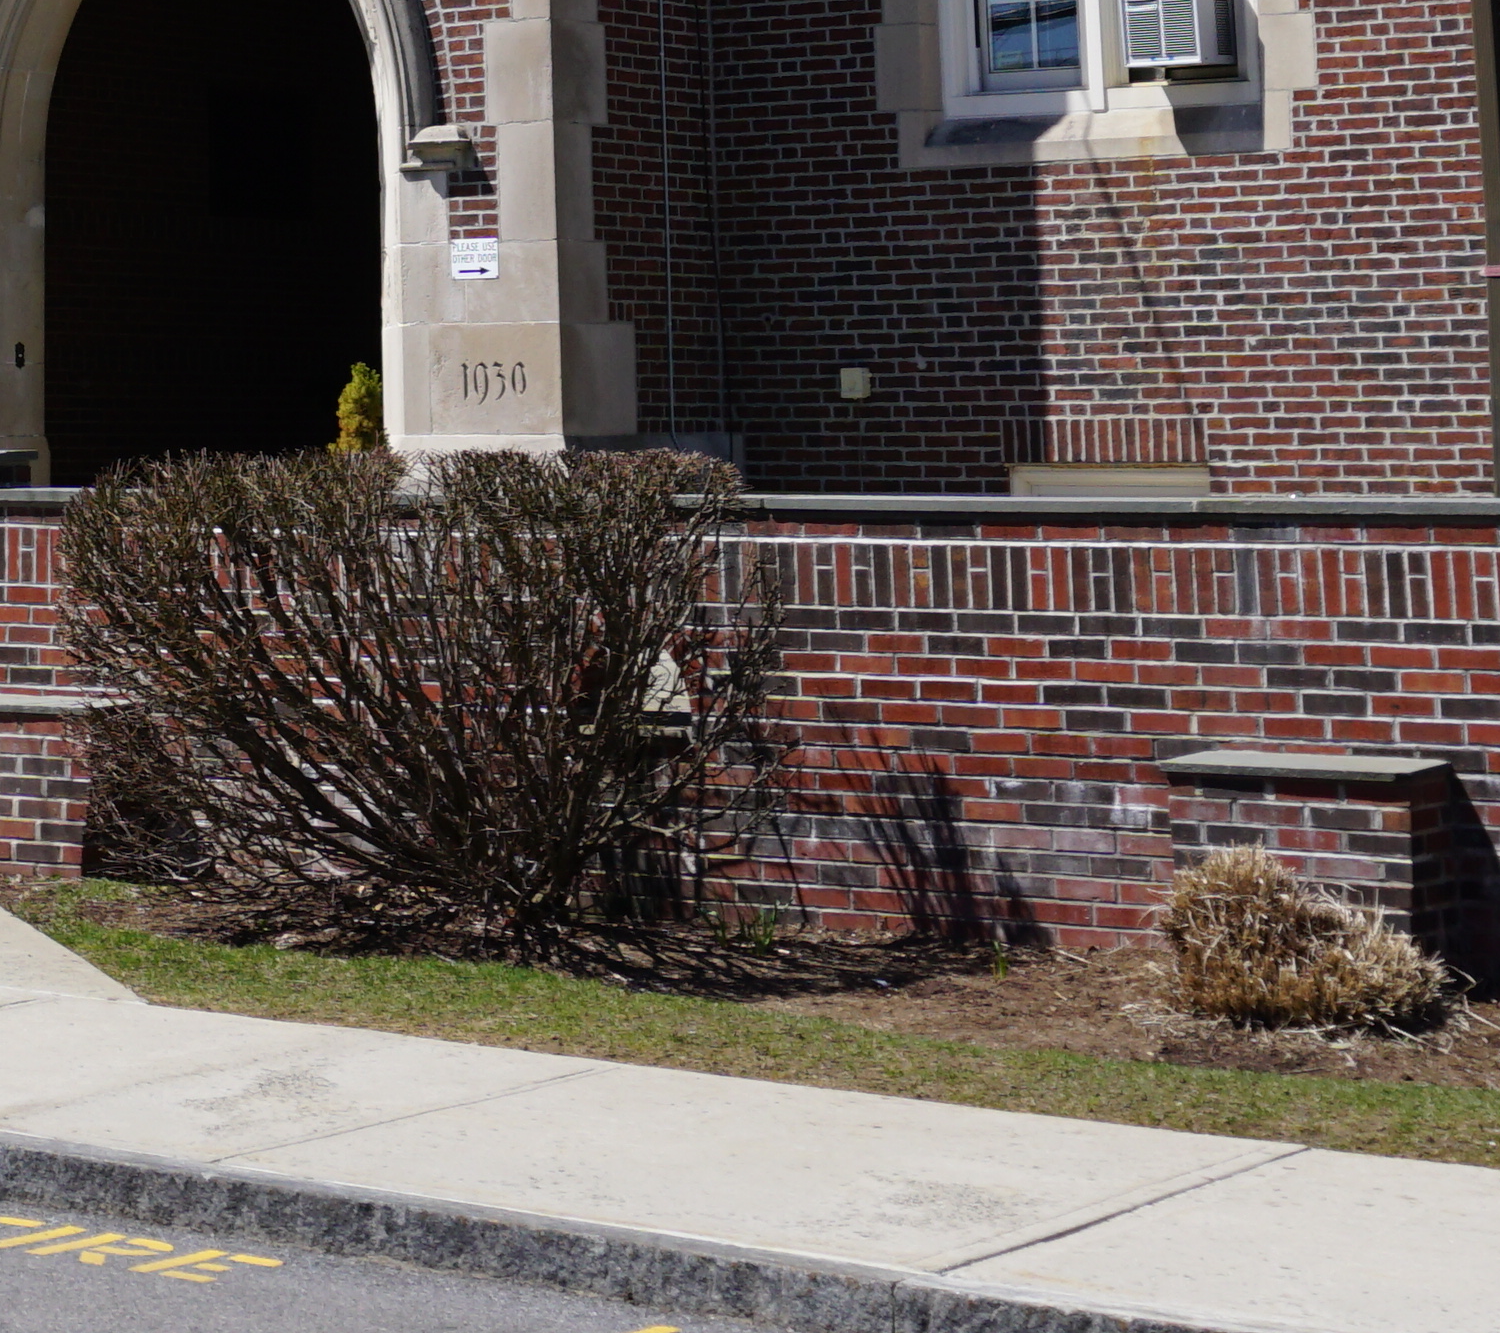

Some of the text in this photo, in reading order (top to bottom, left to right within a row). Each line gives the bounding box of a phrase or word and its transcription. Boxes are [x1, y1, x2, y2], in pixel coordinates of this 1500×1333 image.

[452, 242, 497, 252] PLEASE USE
[452, 253, 497, 263] OTHER DOOR
[460, 360, 528, 406] 1930
